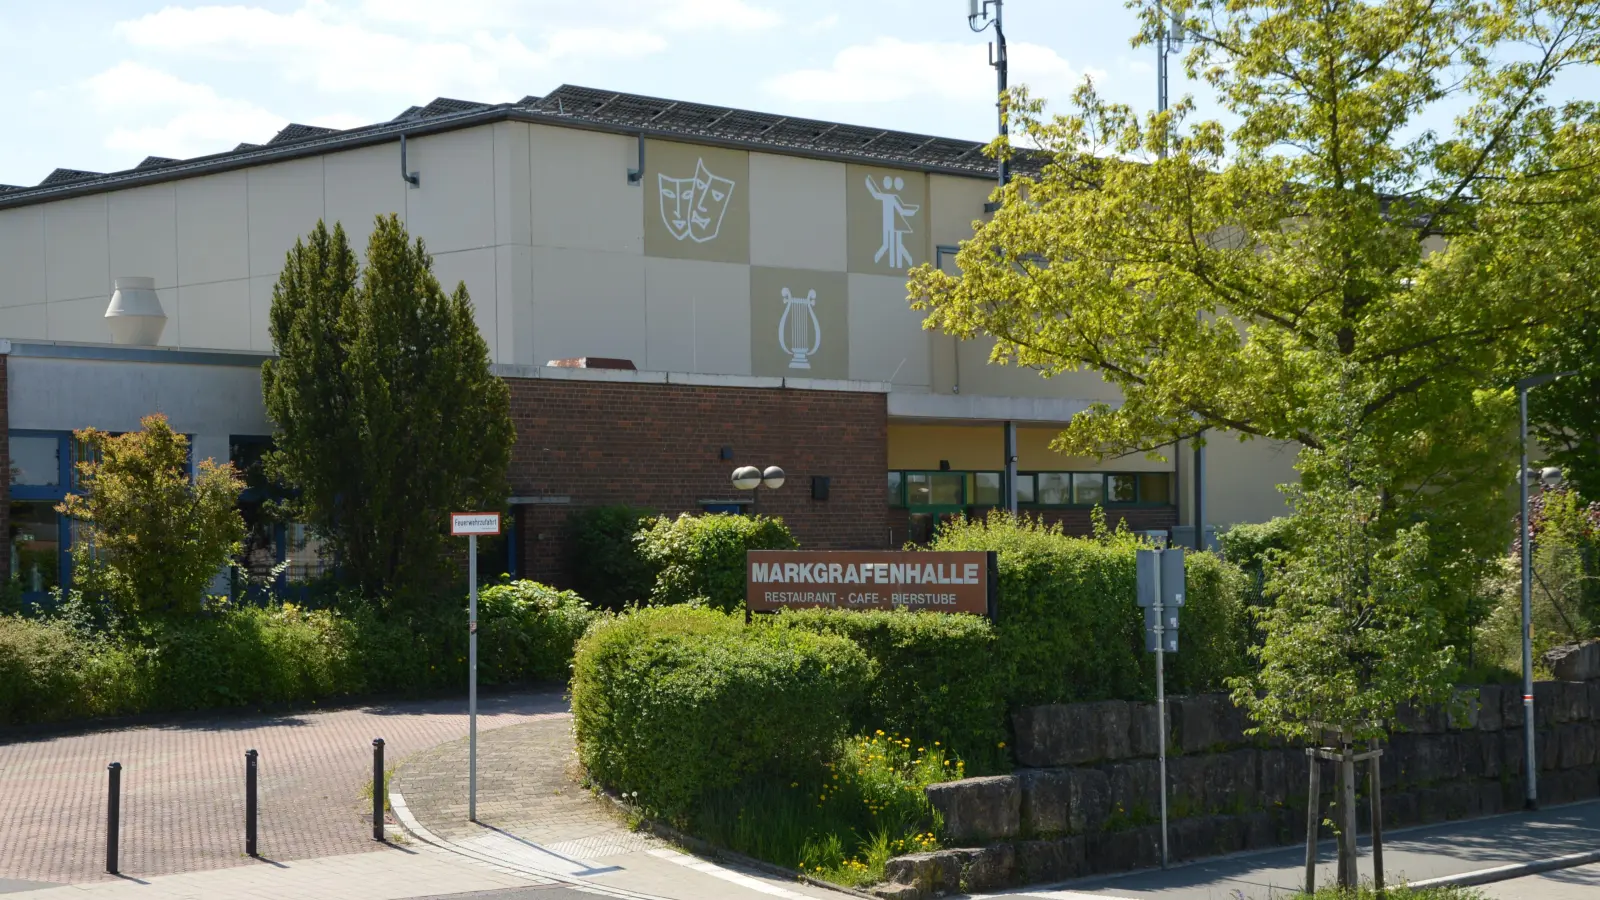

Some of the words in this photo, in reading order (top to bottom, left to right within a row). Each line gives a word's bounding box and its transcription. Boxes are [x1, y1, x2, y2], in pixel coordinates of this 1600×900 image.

[454, 518, 497, 527] Feuerwehrzufahrt
[751, 562, 979, 585] MARKGRAFENHALLE
[764, 591, 837, 603] RESTAURANT
[848, 592, 879, 604] CAFE
[891, 593, 957, 605] BIERSTUBE
